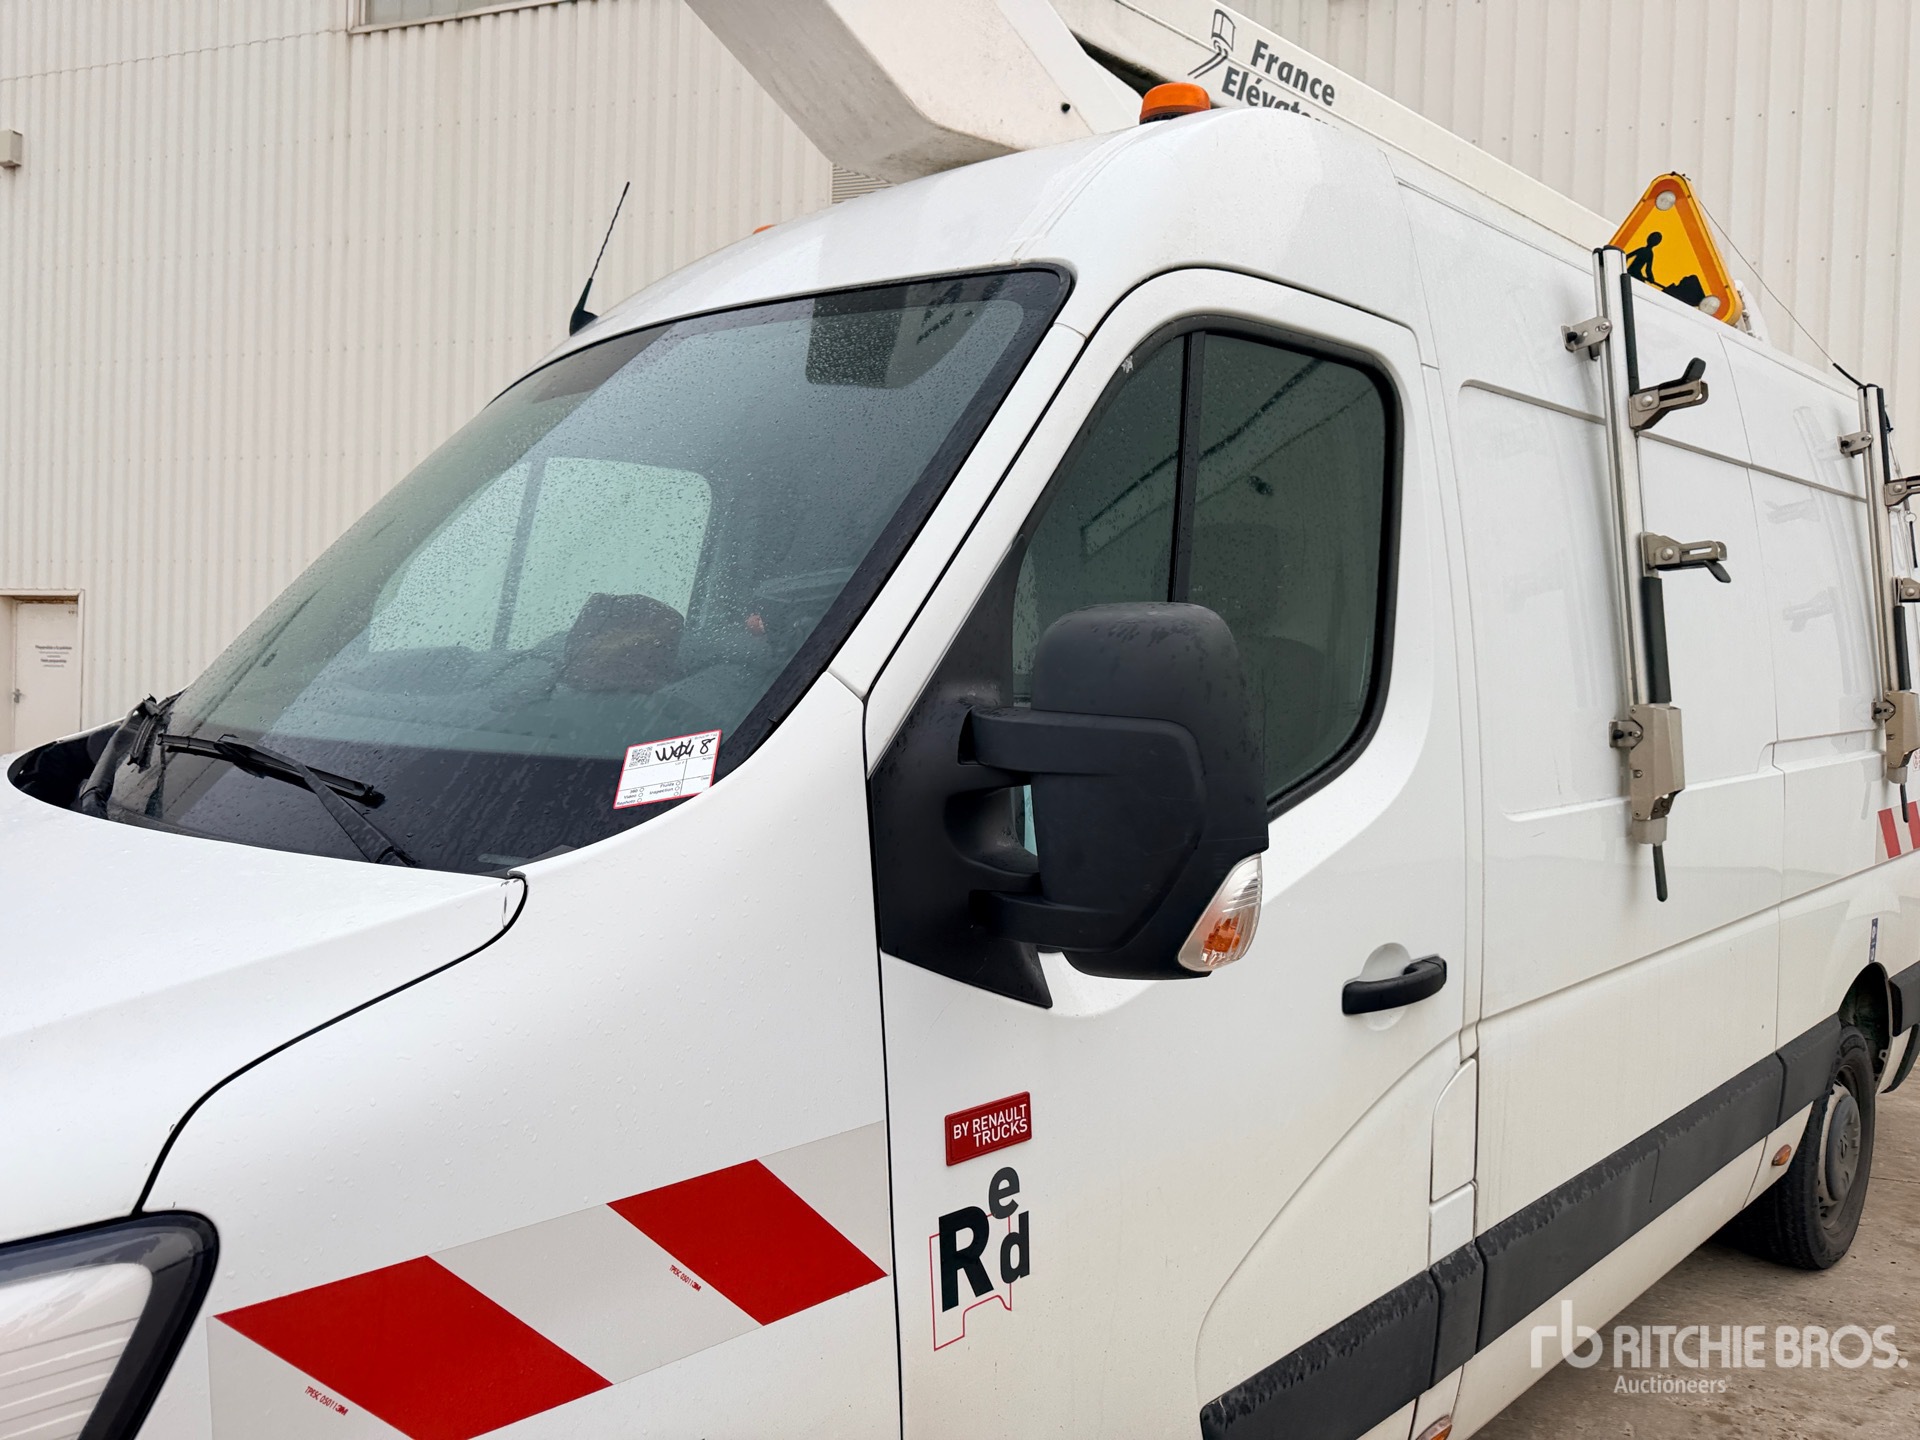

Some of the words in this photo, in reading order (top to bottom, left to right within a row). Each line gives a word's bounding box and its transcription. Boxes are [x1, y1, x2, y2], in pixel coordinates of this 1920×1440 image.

[1250, 39, 1335, 106] France
[953, 1121, 969, 1140] BY
[972, 1103, 1027, 1134] RENAULT
[973, 1118, 1028, 1148] TRUCKS
